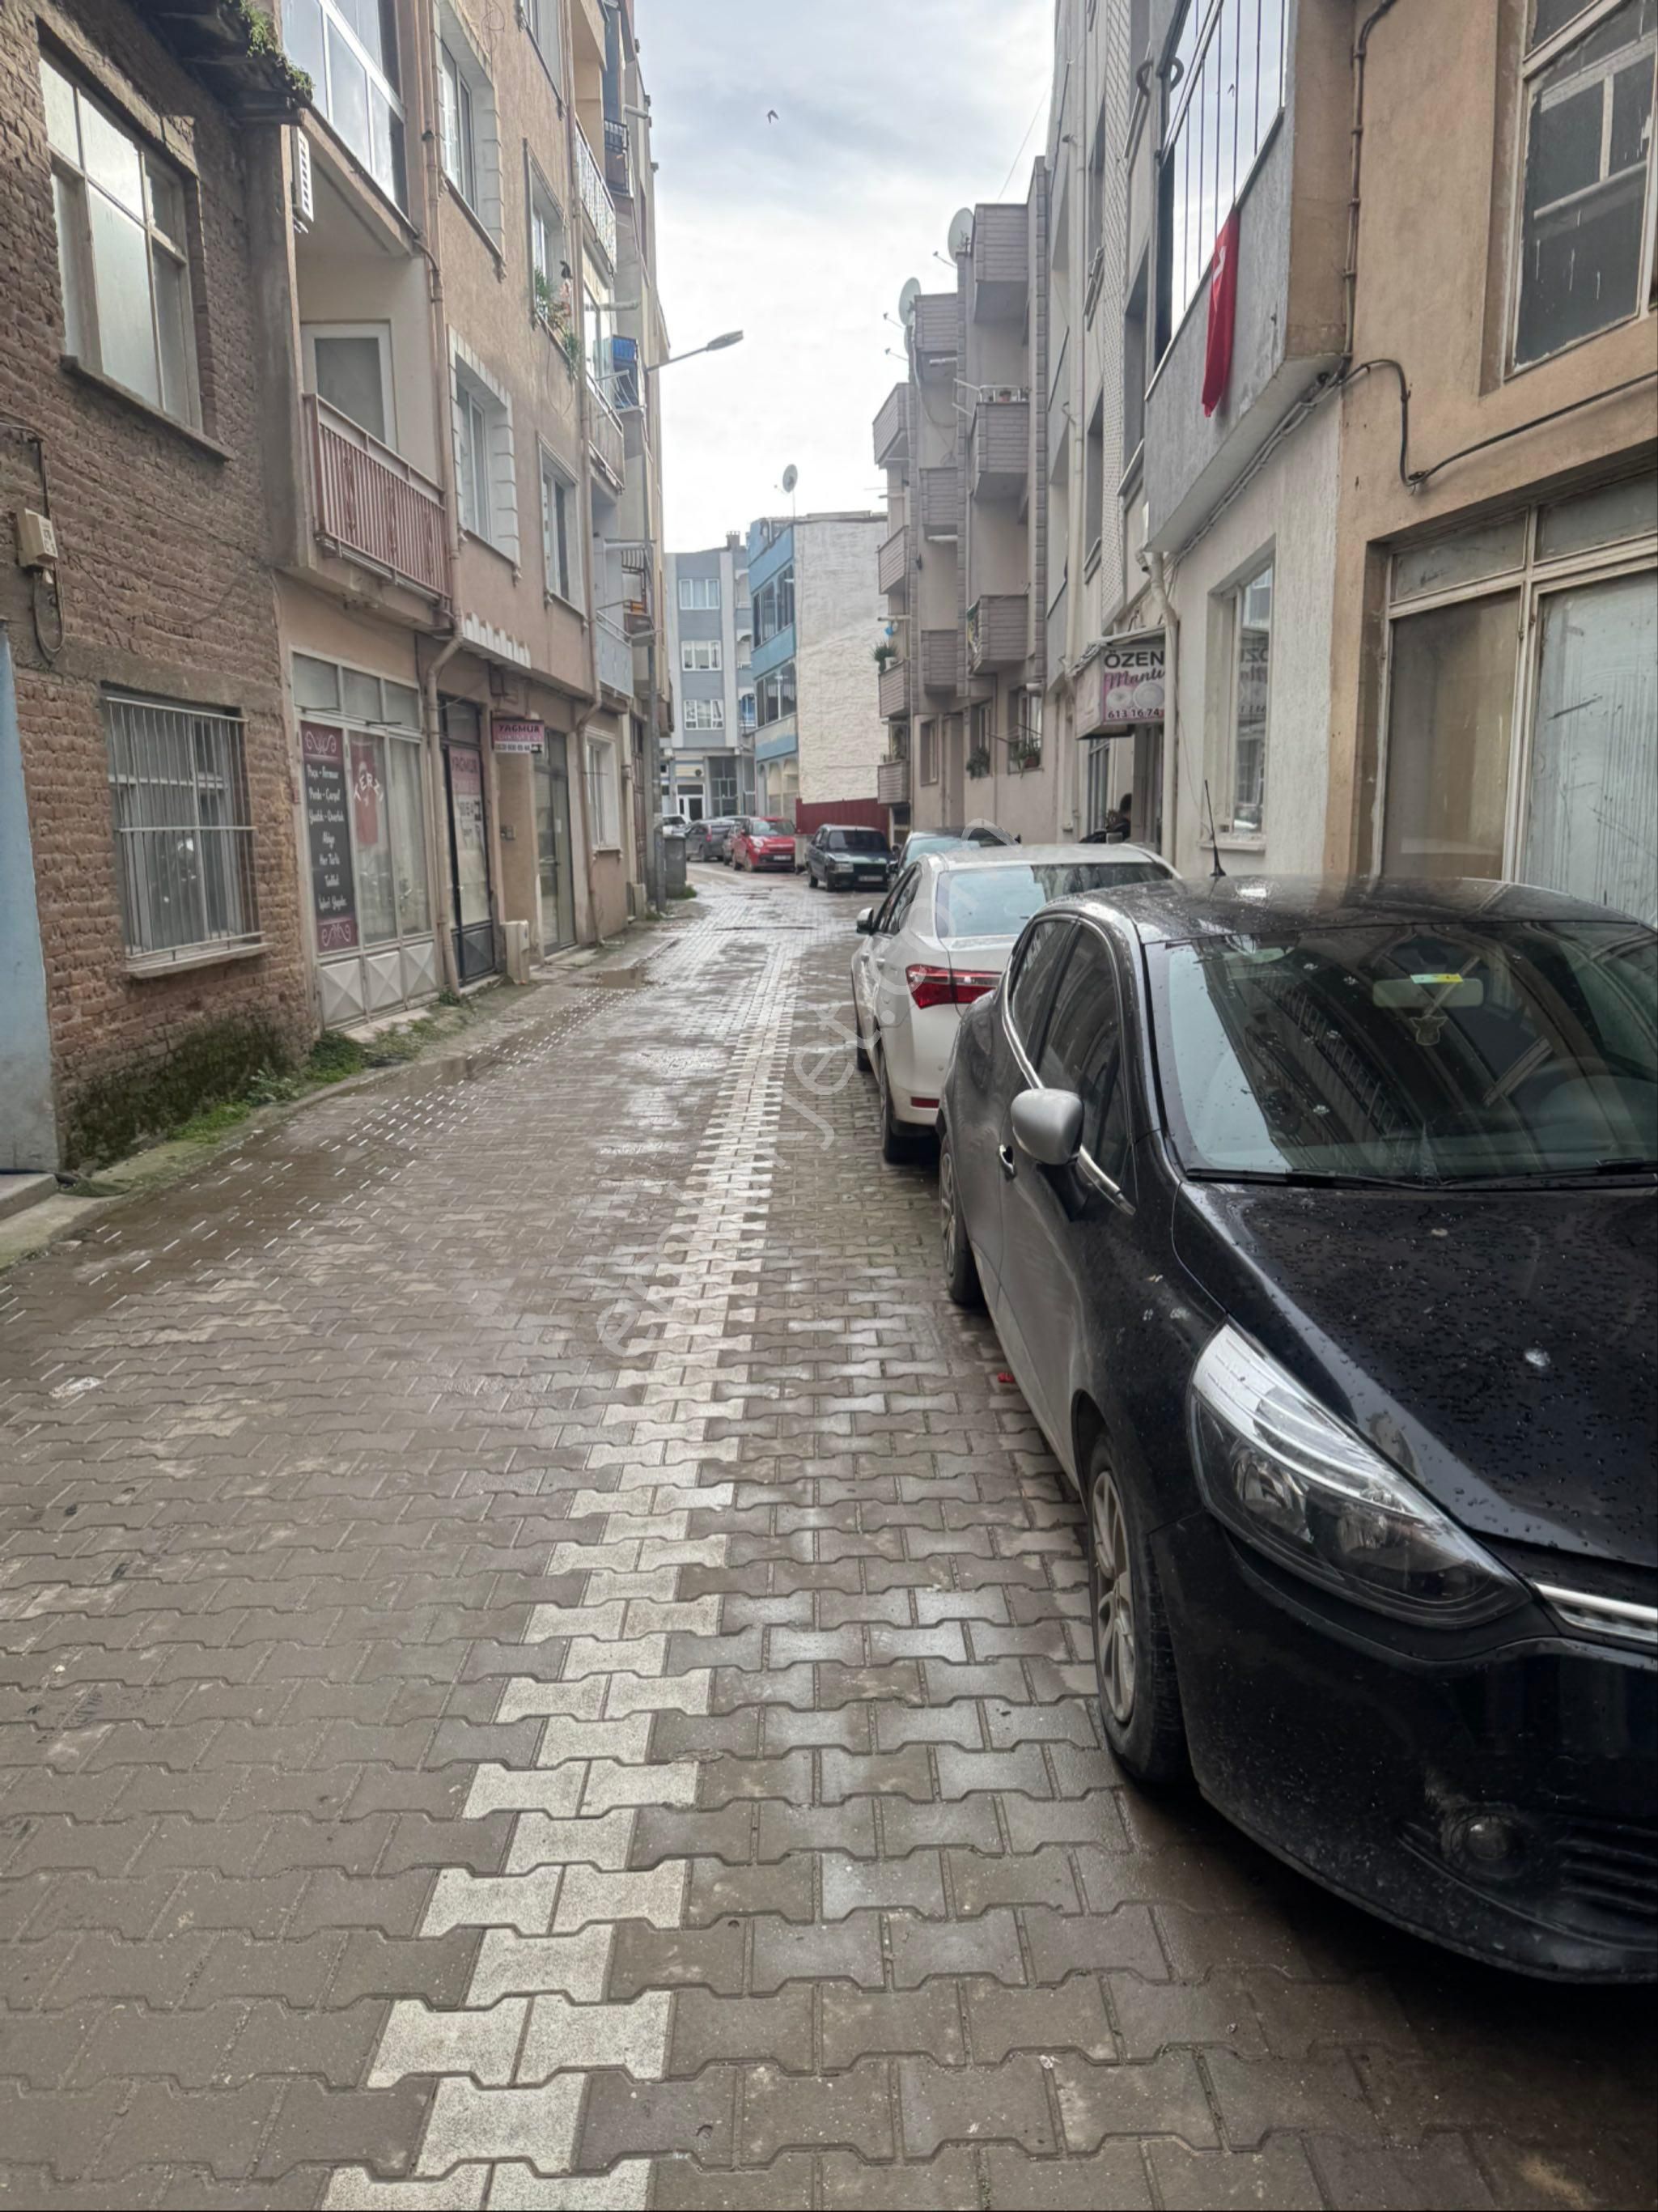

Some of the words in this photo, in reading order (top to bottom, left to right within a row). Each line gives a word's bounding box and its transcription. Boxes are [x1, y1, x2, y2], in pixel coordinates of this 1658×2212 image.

[1104, 649, 1164, 669] ÖZEN
[1108, 709, 1127, 719] 613
[1131, 708, 1143, 718] 16
[1147, 707, 1160, 716] 74
